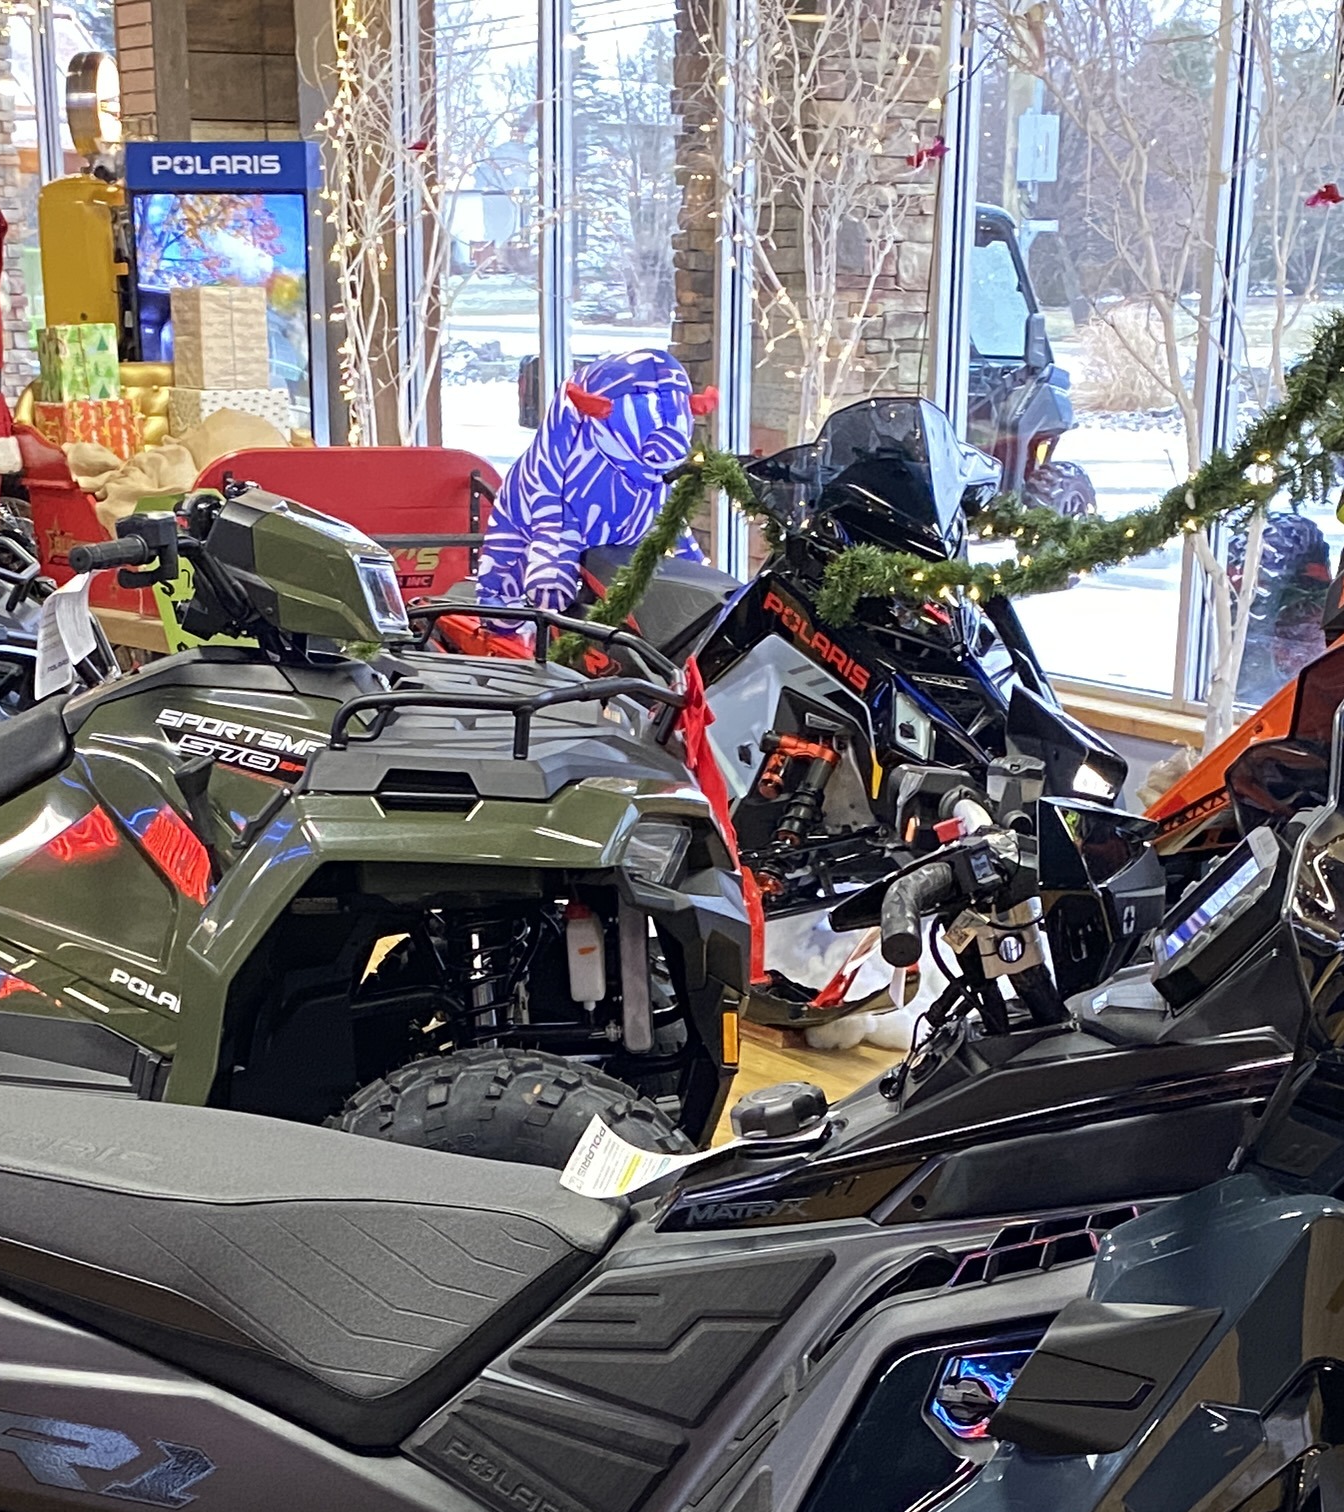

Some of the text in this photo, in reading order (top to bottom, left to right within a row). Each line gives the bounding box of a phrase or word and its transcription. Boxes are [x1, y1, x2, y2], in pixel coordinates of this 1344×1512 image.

[151, 155, 281, 175] POLARIS
[763, 589, 871, 693] POLARIS
[177, 733, 281, 772] 570
[109, 967, 182, 1014] POLA
[576, 1125, 607, 1178] POLARIS
[685, 1200, 808, 1225] MATRYX
